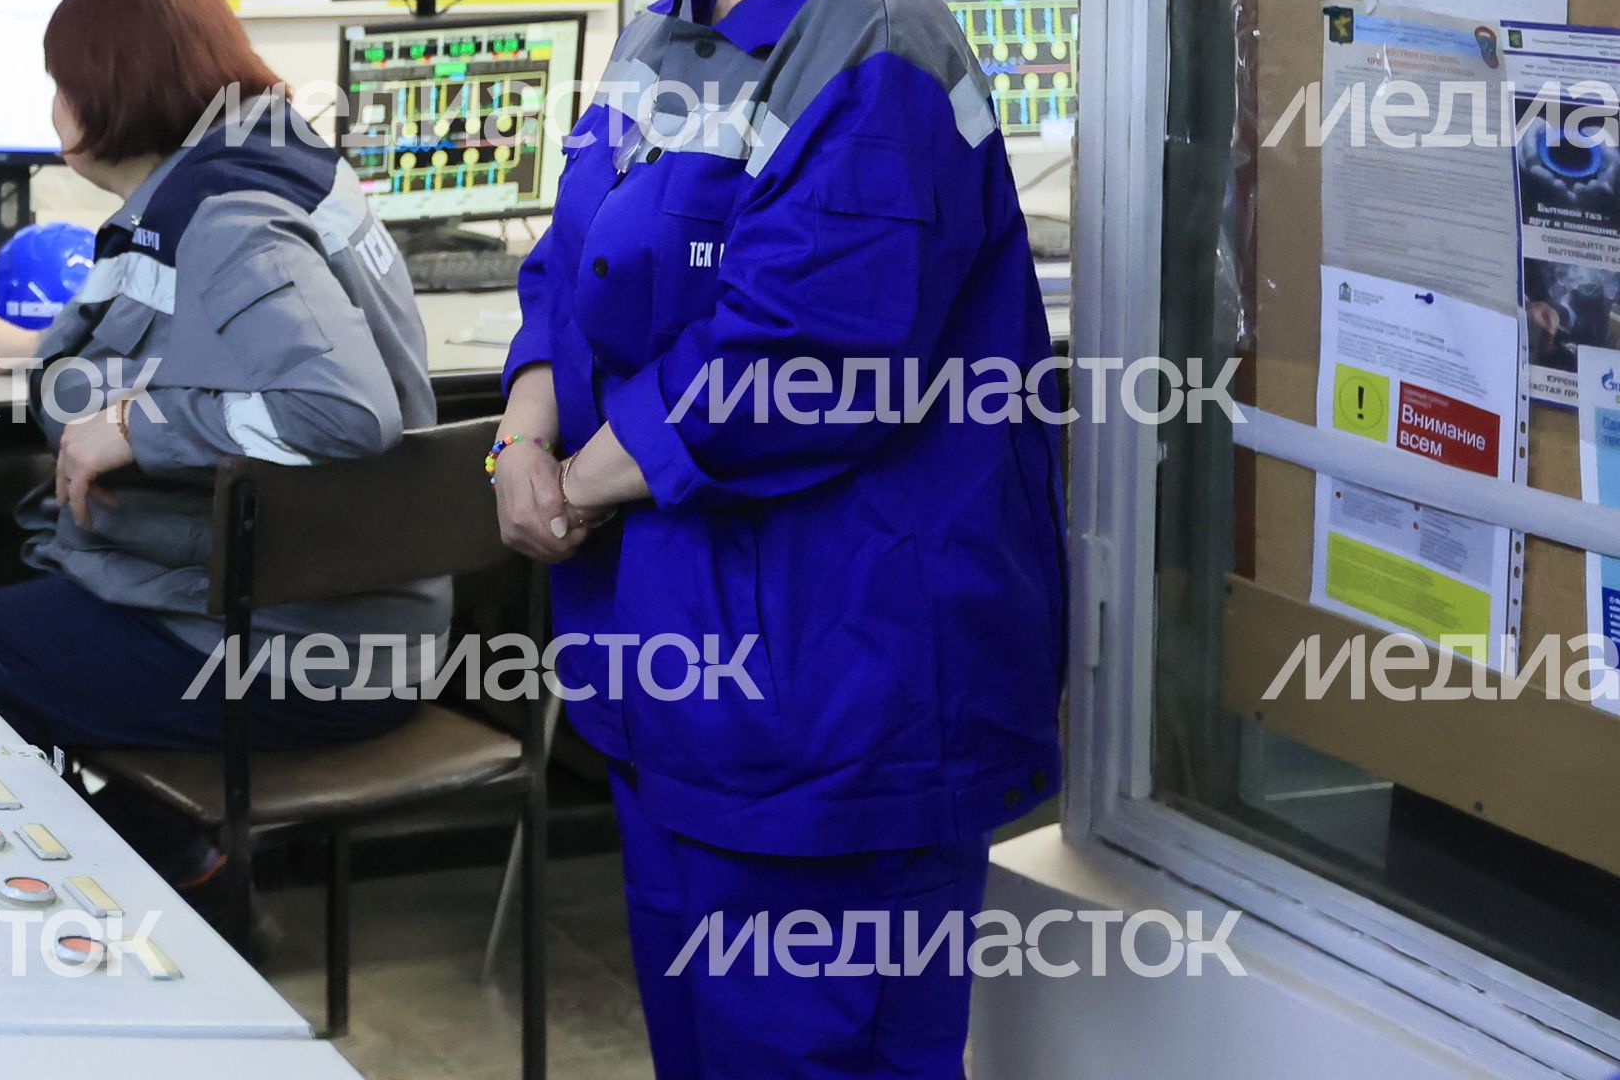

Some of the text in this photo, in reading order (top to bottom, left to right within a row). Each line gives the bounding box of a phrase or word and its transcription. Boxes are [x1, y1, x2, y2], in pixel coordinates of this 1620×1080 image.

[689, 241, 714, 268] ТСК
[1402, 403, 1486, 451] Внимание
[1400, 430, 1443, 457] всем
